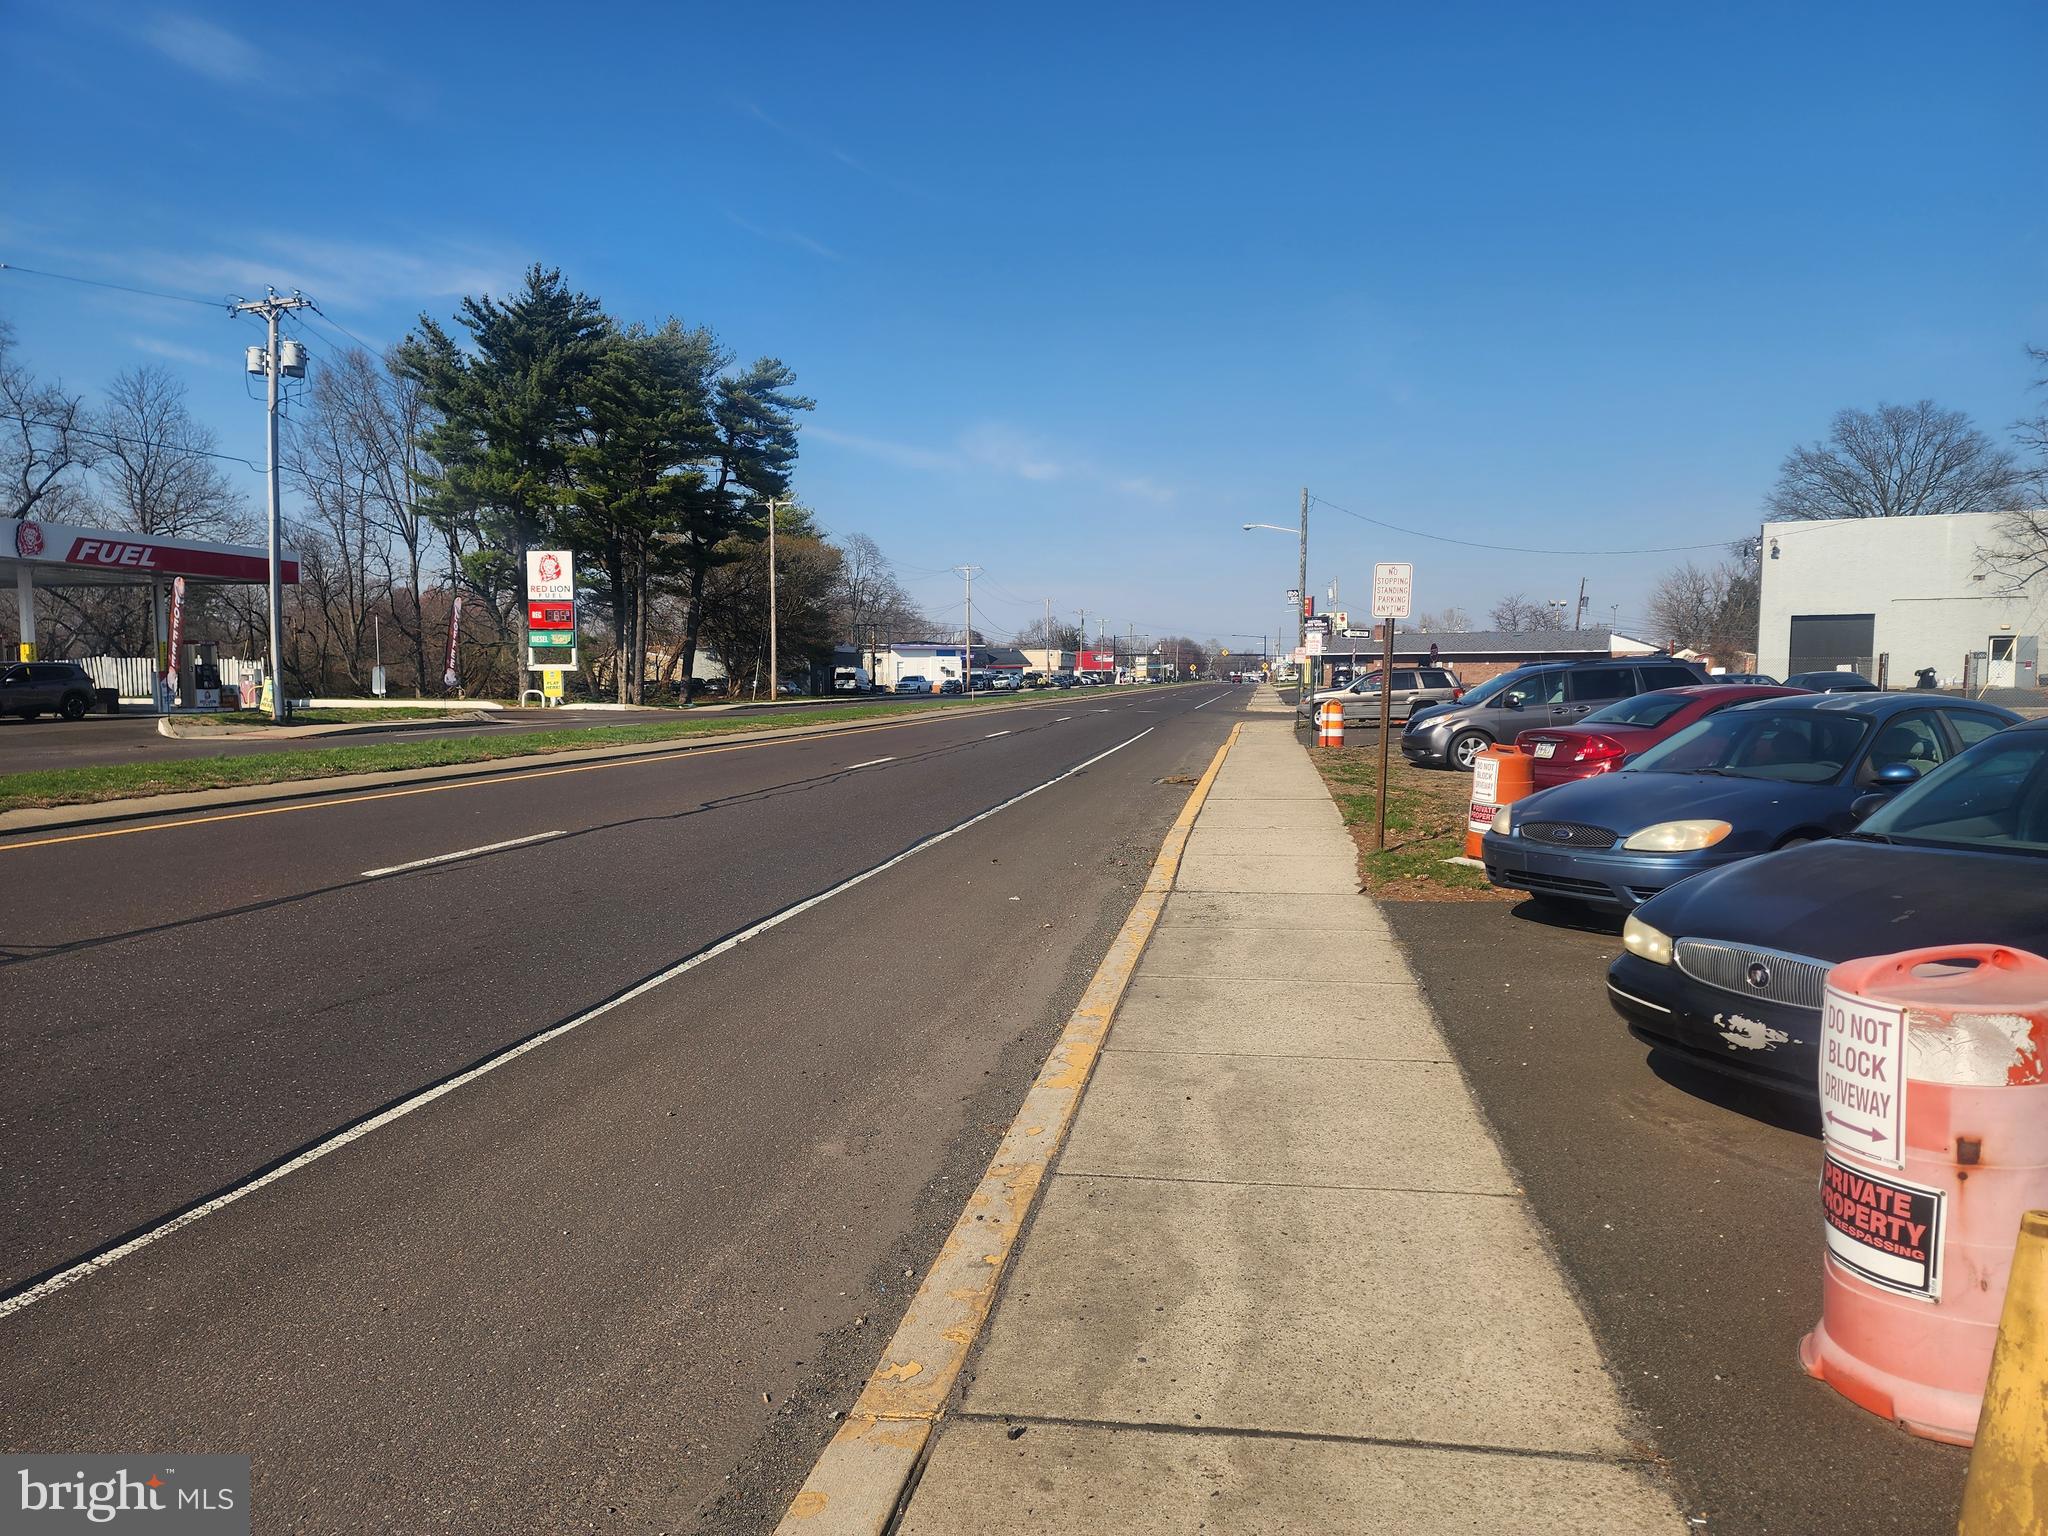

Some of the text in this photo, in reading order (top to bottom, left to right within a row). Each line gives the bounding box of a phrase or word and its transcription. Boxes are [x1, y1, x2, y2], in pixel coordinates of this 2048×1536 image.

[76, 541, 156, 567] FUEL
[1377, 577, 1409, 585] STOPPING
[530, 585, 571, 593] RED LION
[1377, 586, 1408, 594] STANDING
[1378, 595, 1406, 603] PARKING
[1376, 605, 1406, 613] ANYTIME
[171, 596, 184, 668] COFFEE
[1477, 761, 1494, 772] DO NOT
[1476, 770, 1493, 781] BLOCK
[1473, 804, 1496, 813] PRIVATE
[1828, 1005, 1892, 1047] DO NOT
[1828, 1039, 1887, 1083] BLOCK
[1825, 1072, 1891, 1119] DRIVEWAY
[1825, 1162, 1912, 1218] PRIVATE
[1830, 1214, 1925, 1261] TRESPASSING
